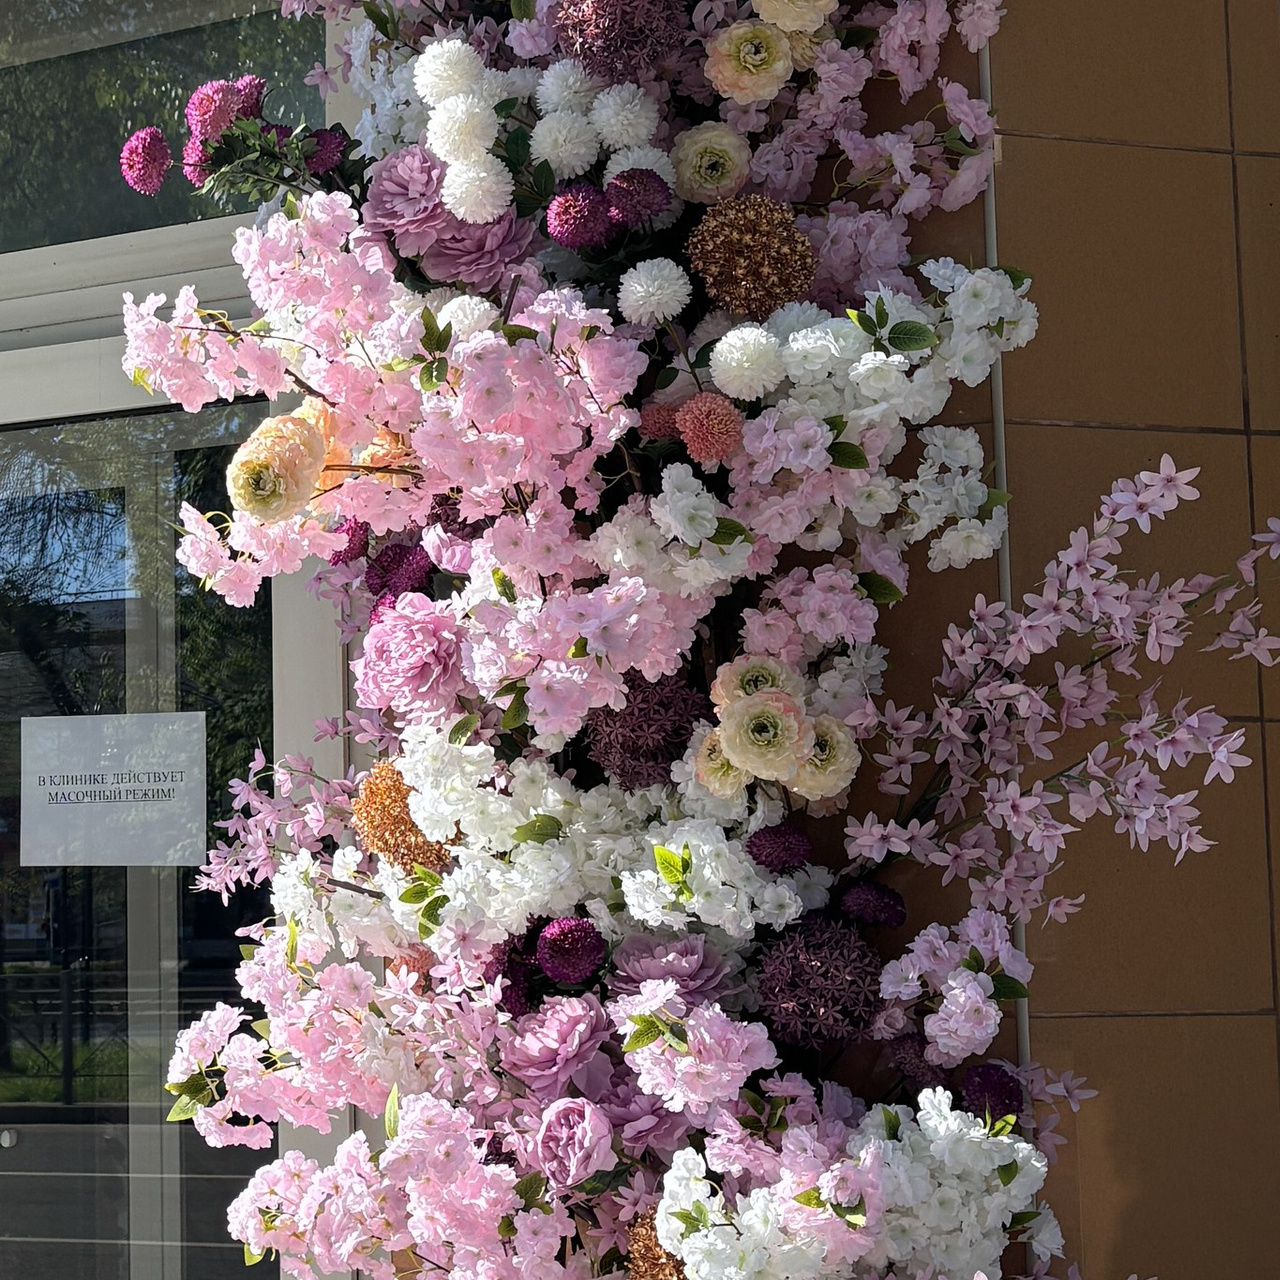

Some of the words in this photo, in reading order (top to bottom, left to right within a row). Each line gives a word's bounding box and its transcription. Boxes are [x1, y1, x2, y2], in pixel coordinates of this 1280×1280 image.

[37, 774, 46, 786] В
[49, 773, 109, 786] КЛИНИКЕ
[111, 770, 186, 786] ДЕЙСТВУЕТ
[48, 787, 122, 803] МАСОЧНЫЙ
[125, 787, 176, 801] РЕЖИМ!
